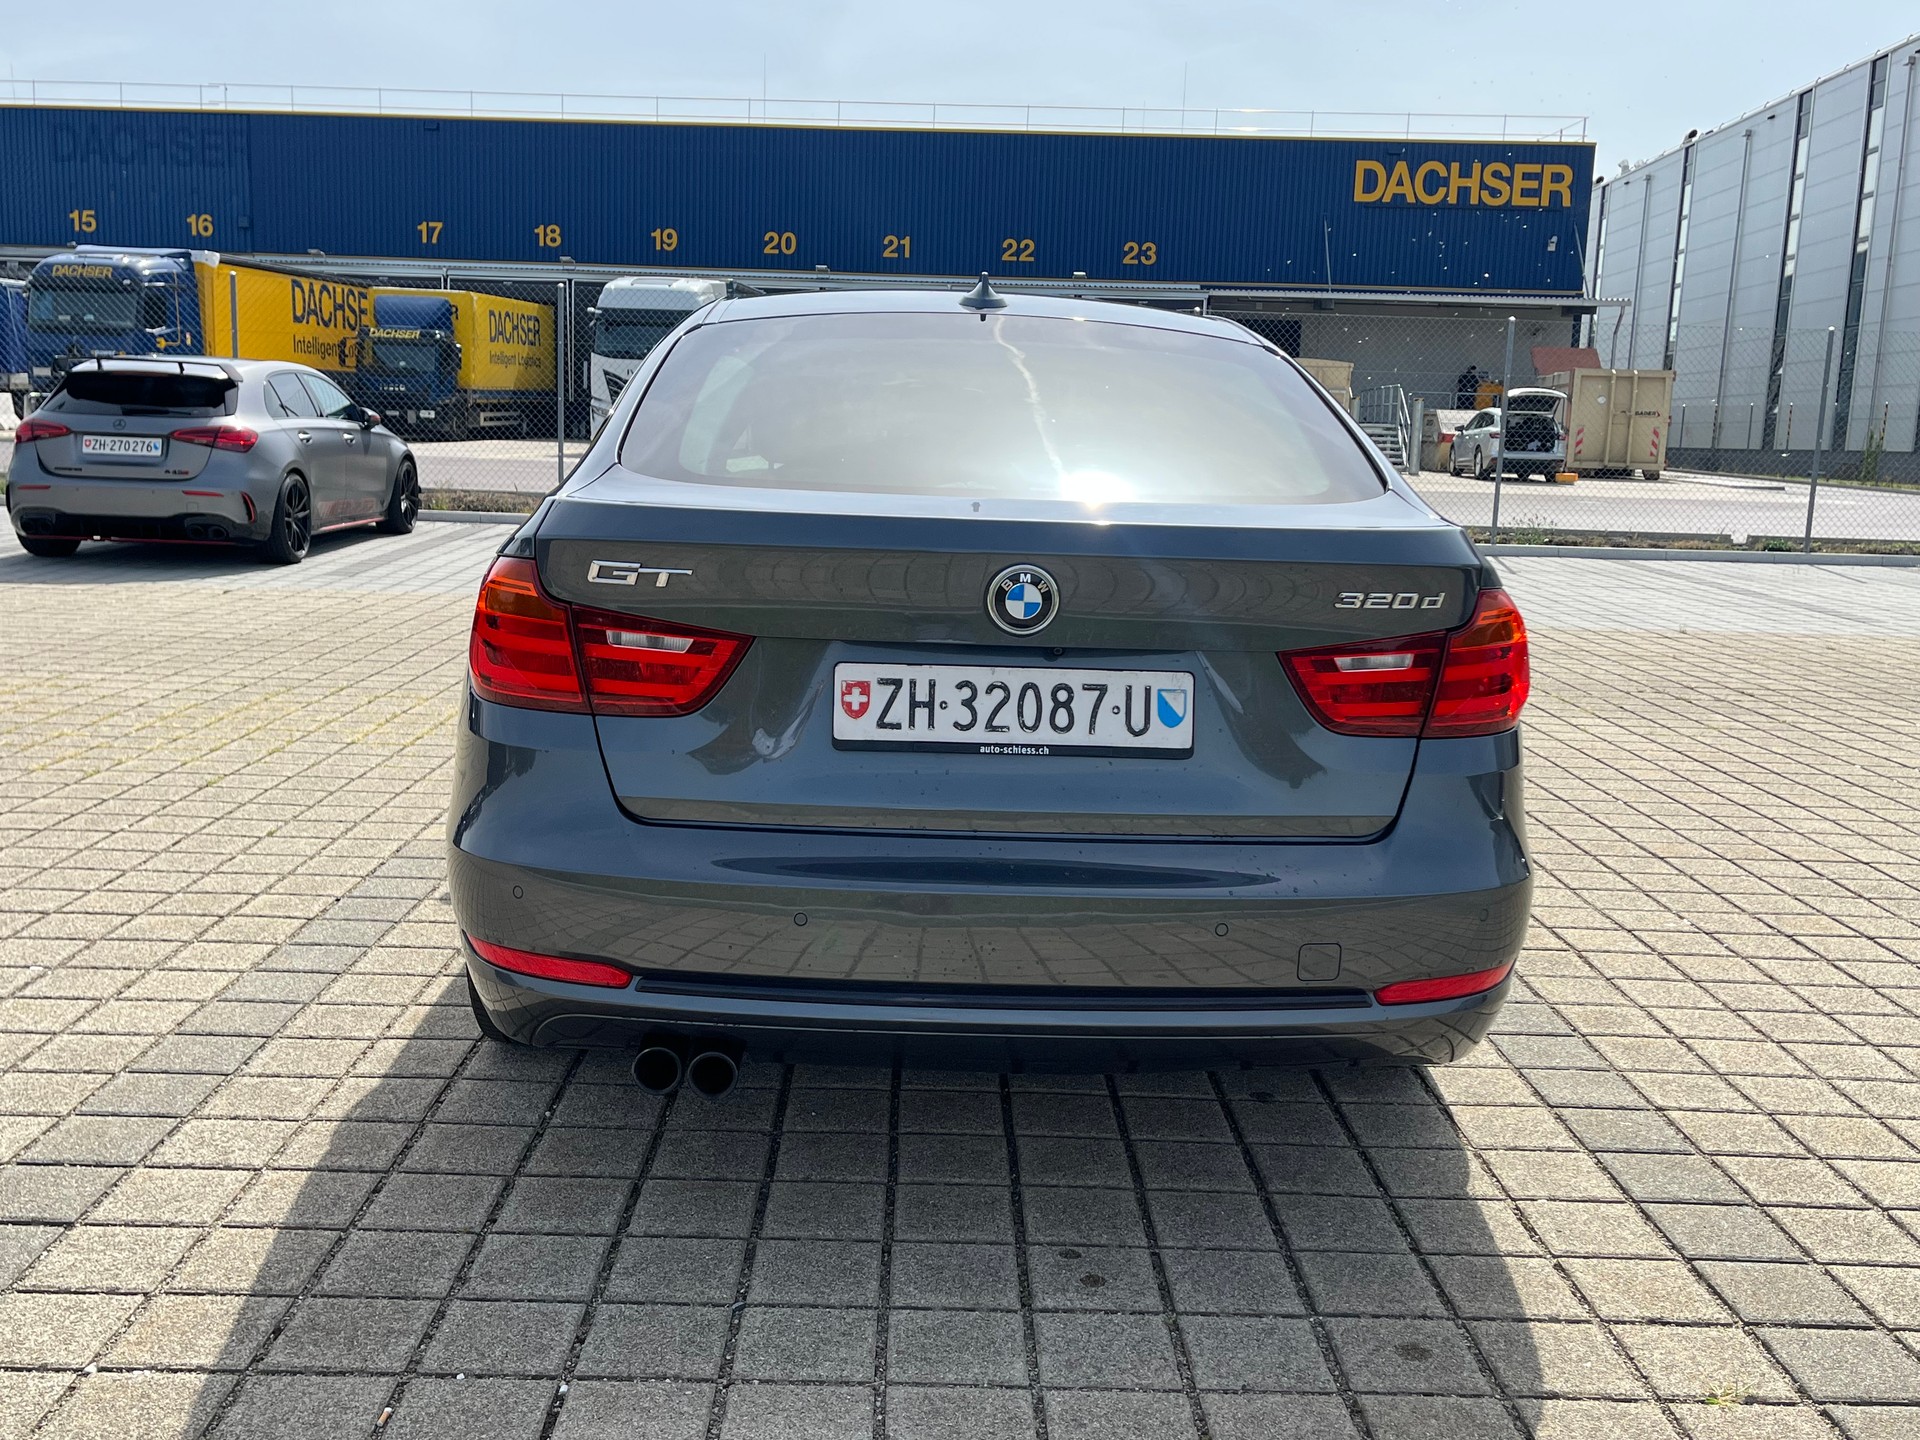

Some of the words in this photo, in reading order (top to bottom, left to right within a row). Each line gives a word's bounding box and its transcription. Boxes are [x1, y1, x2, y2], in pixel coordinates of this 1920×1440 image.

[1353, 159, 1574, 208] DACHSER
[70, 209, 97, 233] 15
[187, 213, 214, 238] 16
[417, 221, 444, 244] 17
[534, 225, 562, 248] 18
[651, 228, 679, 252] 19
[763, 231, 797, 255] 20
[883, 234, 911, 258] 21
[1002, 238, 1036, 262] 22
[1122, 242, 1157, 265] 23
[52, 264, 113, 278] DACHSER
[291, 278, 369, 331] DACHSE
[369, 327, 421, 340] DACHSER
[488, 309, 541, 347] DACHSER
[587, 560, 693, 588] GT
[1001, 573, 1049, 594] BMW
[1334, 592, 1446, 609] 320d
[979, 744, 1050, 756] auto-schiess.ch
